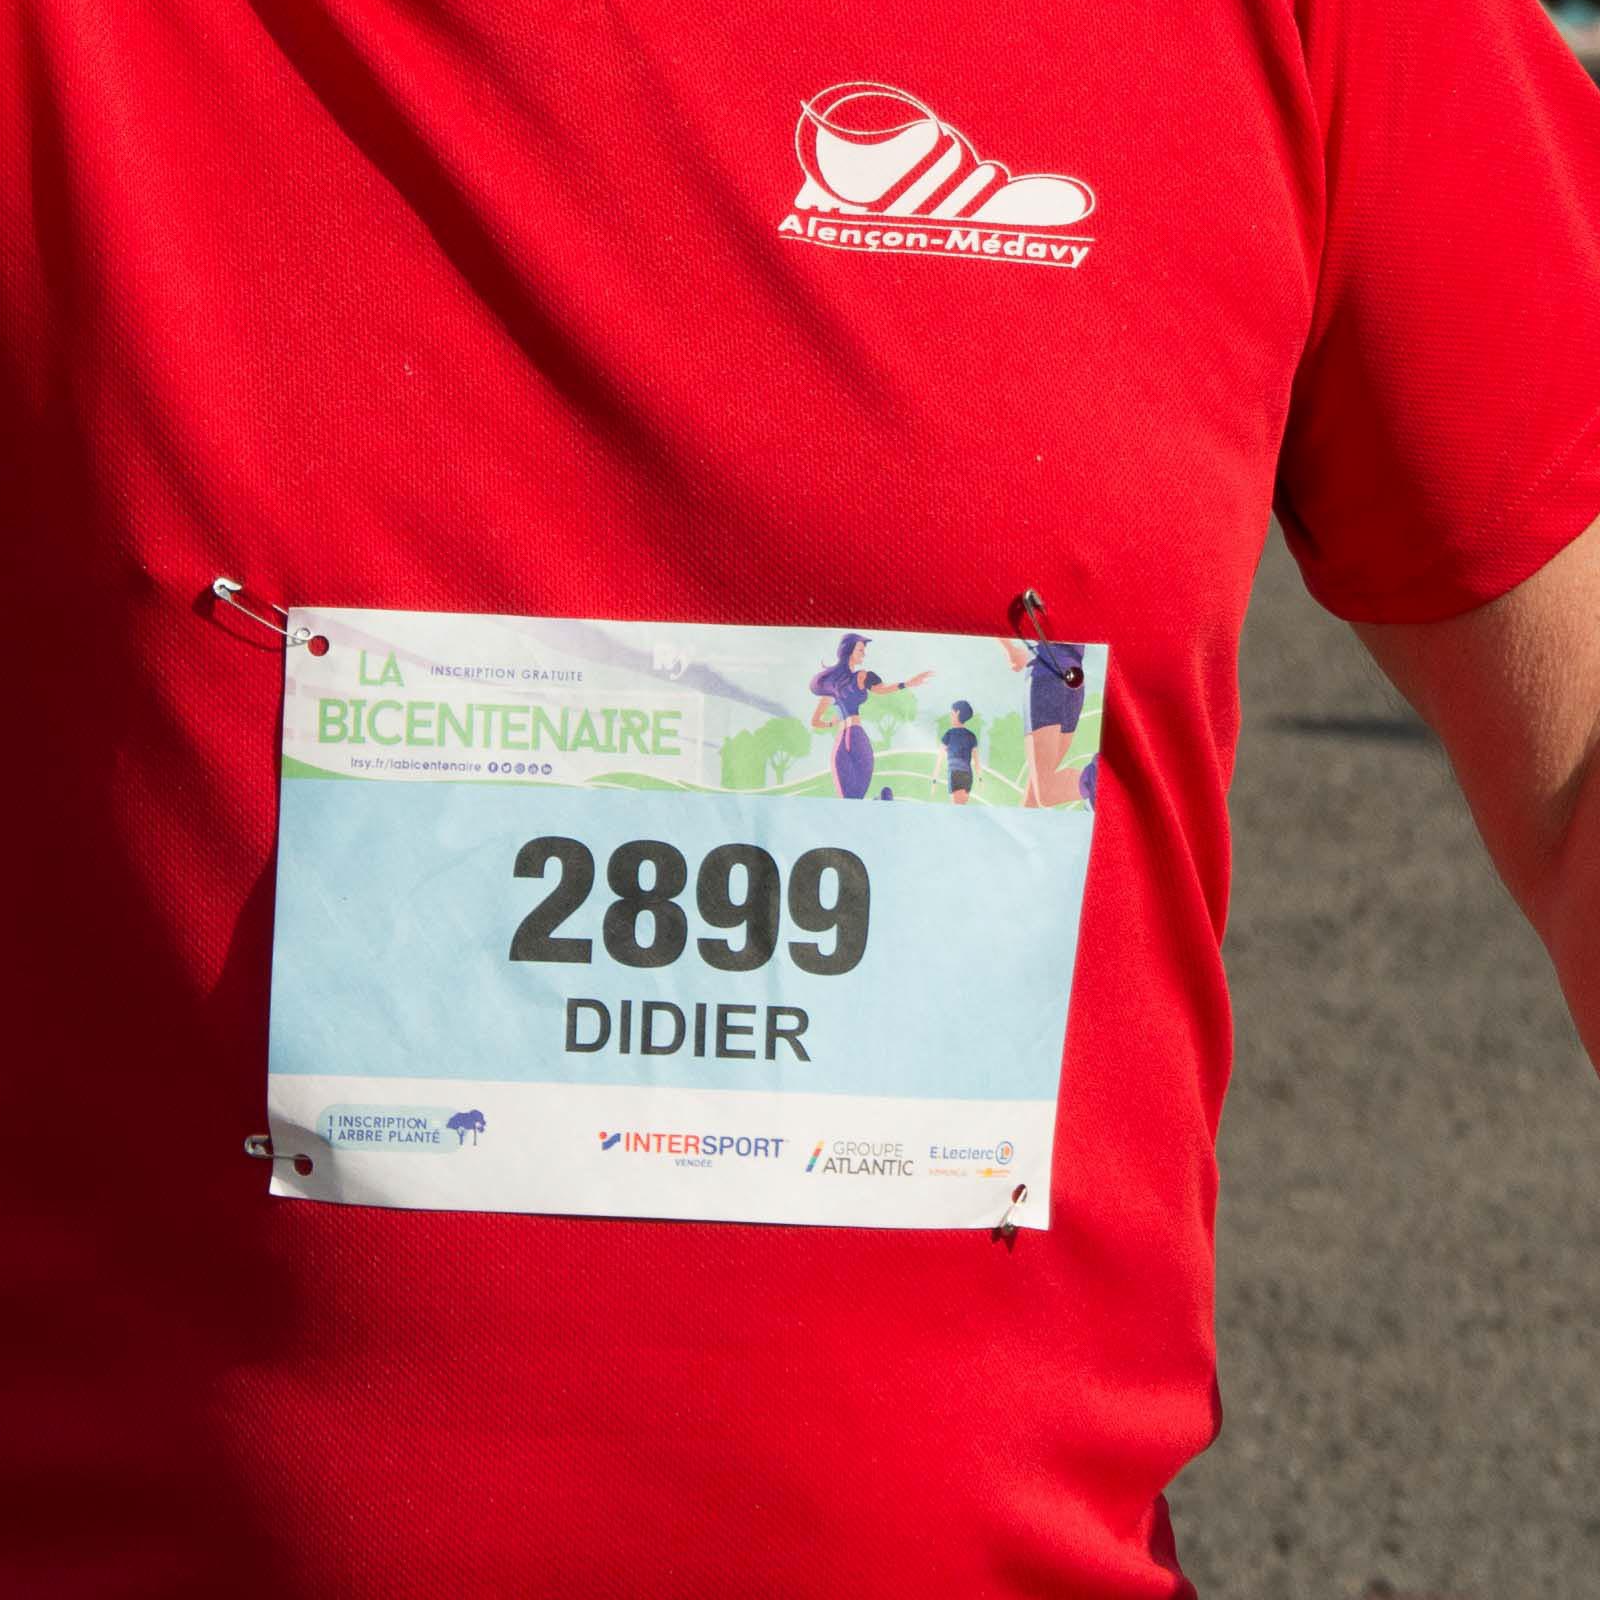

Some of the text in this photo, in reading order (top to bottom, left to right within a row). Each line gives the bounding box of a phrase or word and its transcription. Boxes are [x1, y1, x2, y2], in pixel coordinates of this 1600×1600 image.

[778, 213, 1090, 262] Alençon-Médavy
[359, 649, 405, 688] LA
[430, 665, 583, 682] INSCRIPTION GRATUITE
[317, 696, 682, 757] BICENTENAIRE
[508, 835, 872, 976] 2899
[564, 997, 812, 1063] DIDIER
[339, 1115, 427, 1129] INSCRIPTION
[338, 1129, 382, 1142] ARBRE
[388, 1128, 440, 1144] PLANTÉ
[624, 1131, 785, 1158] INTERSPORT
[832, 1140, 904, 1158] GROUPE
[823, 1157, 914, 1177] ATLANTIC
